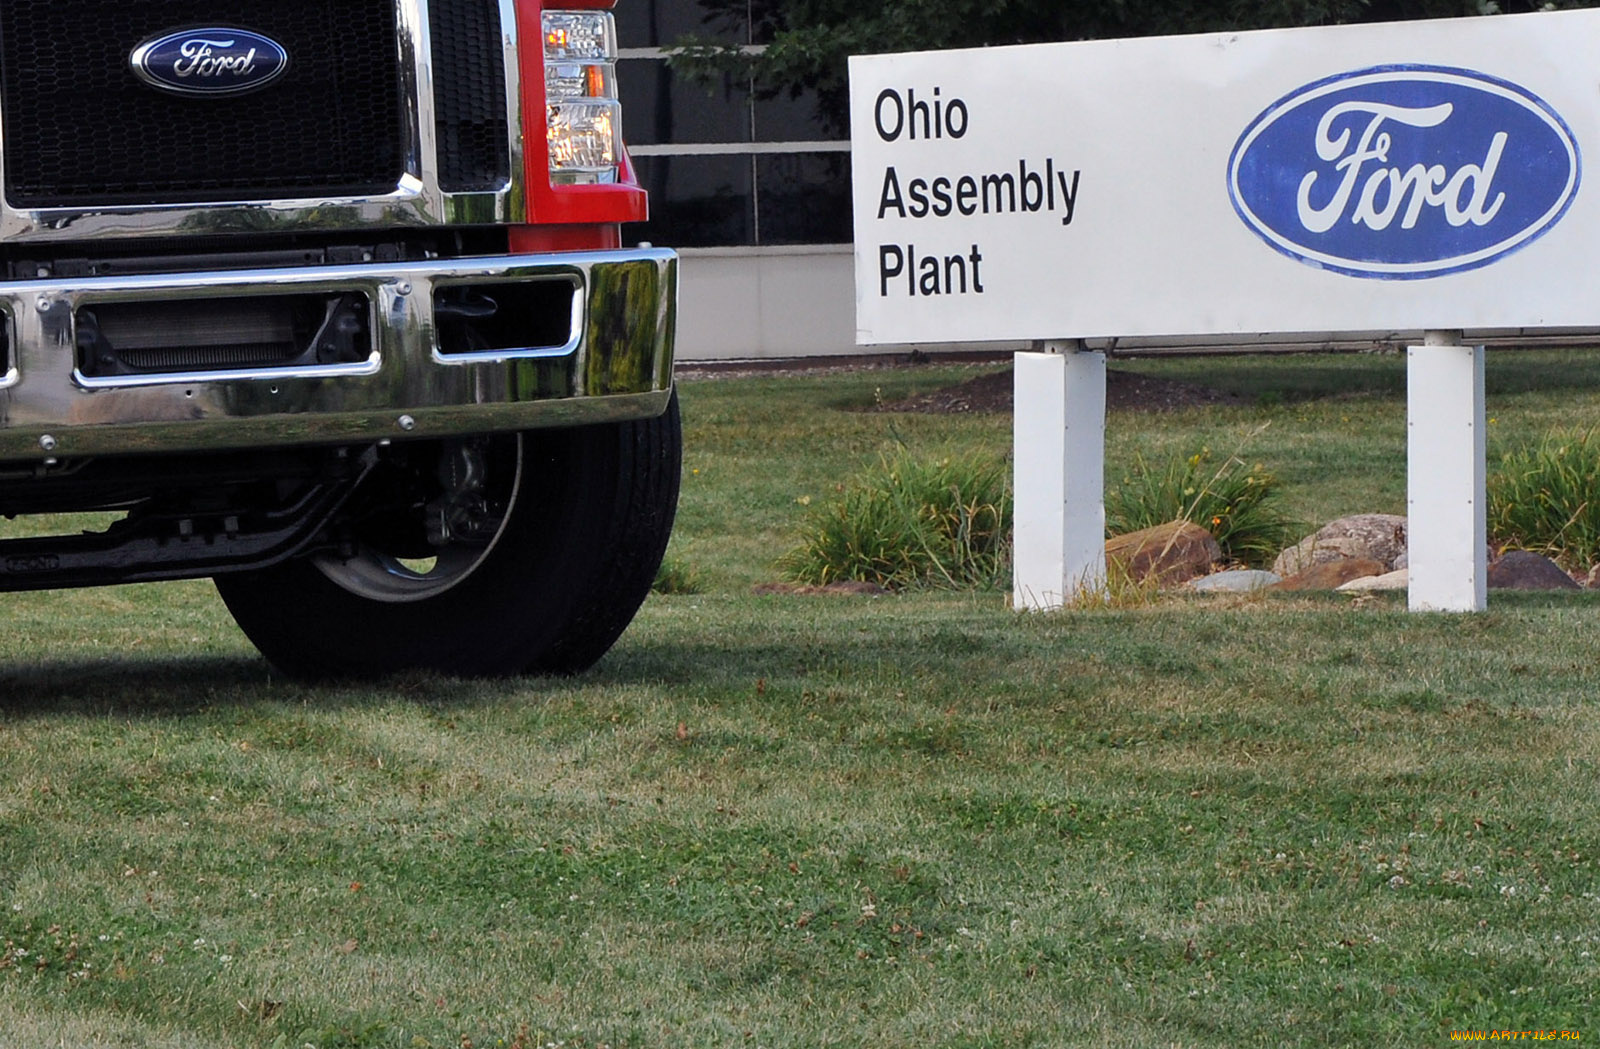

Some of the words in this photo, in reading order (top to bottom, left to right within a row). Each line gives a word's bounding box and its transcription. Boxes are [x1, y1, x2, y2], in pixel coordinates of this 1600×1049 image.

[173, 39, 256, 77] Ford
[874, 87, 968, 142] Ohio
[877, 158, 1081, 226] Assembly
[1298, 100, 1508, 233] Ford
[879, 244, 984, 297] Plant
